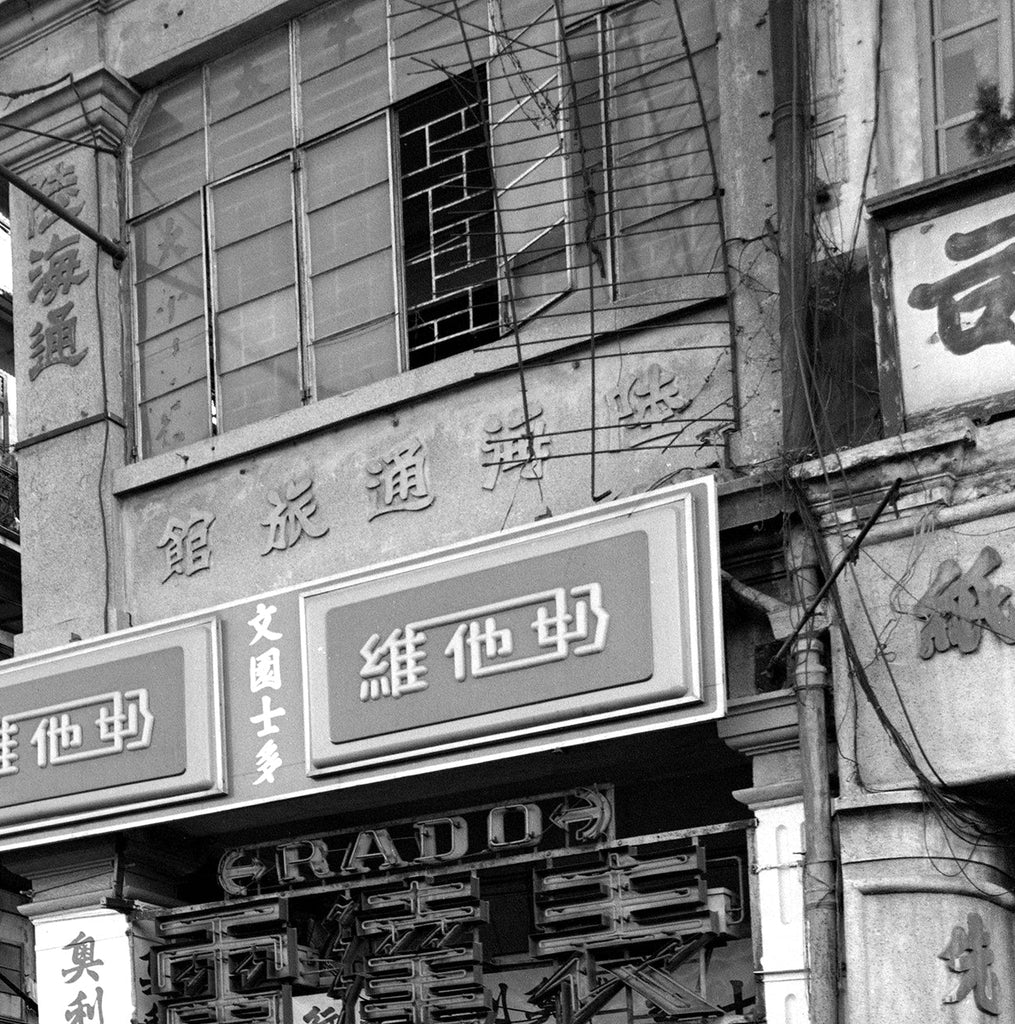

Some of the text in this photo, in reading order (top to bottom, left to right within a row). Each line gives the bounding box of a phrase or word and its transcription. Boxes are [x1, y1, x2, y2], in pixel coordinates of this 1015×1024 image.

[359, 582, 610, 702] 維他奶
[276, 803, 544, 885] RADO
